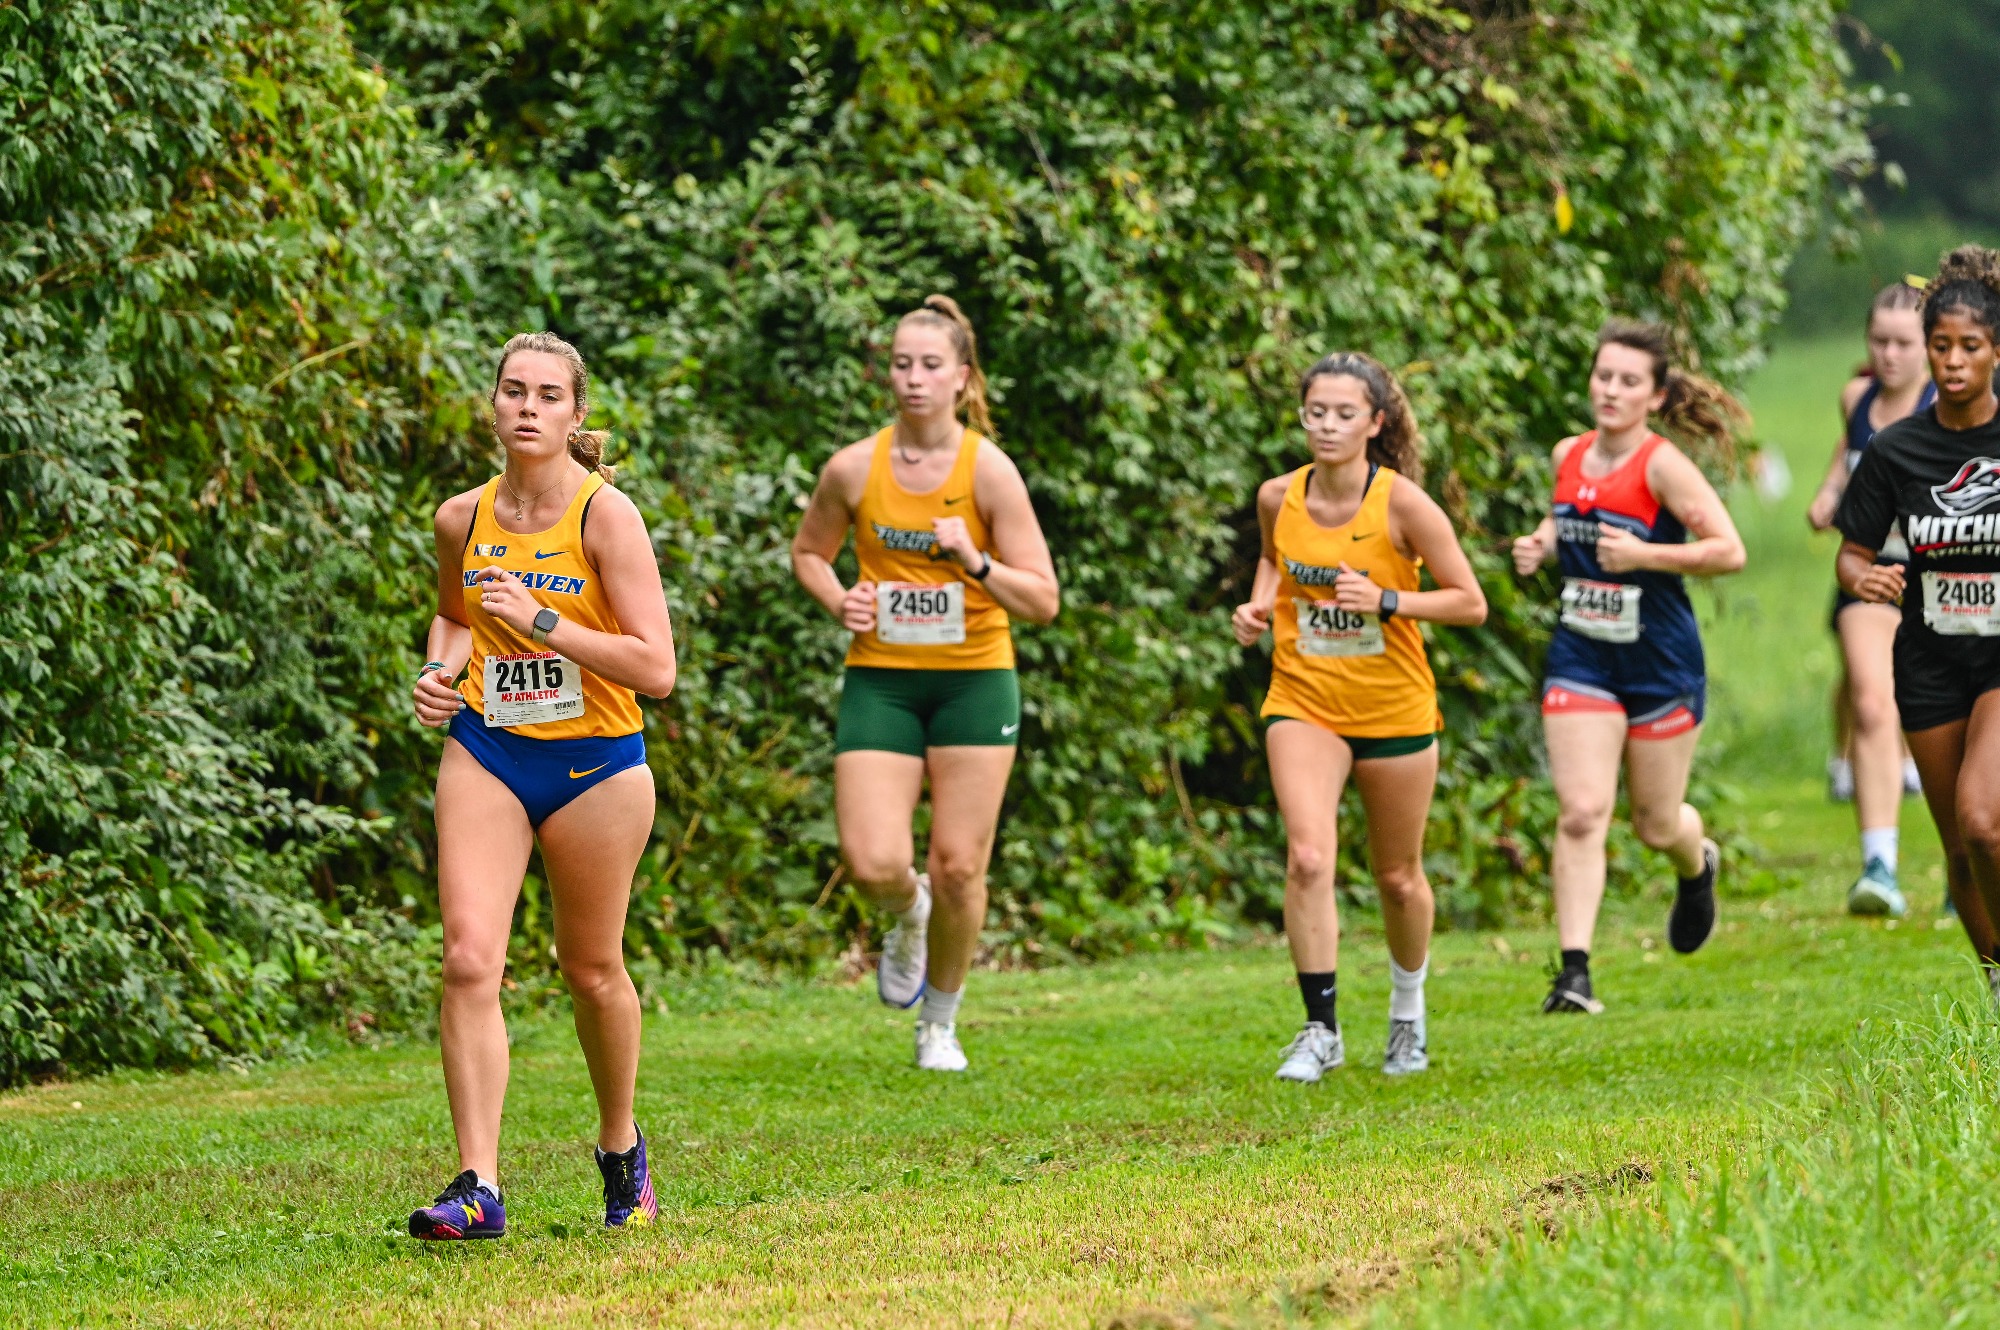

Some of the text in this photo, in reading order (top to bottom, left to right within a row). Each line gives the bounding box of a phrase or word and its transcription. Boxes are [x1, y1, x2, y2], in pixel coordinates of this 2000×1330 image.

[474, 543, 507, 557] NE10
[890, 590, 948, 615] 2450
[1937, 580, 1996, 606] 2408
[495, 652, 557, 662] CHAMPIONSHIP
[495, 658, 564, 693] 2415
[515, 689, 560, 702] ATHLETIC
